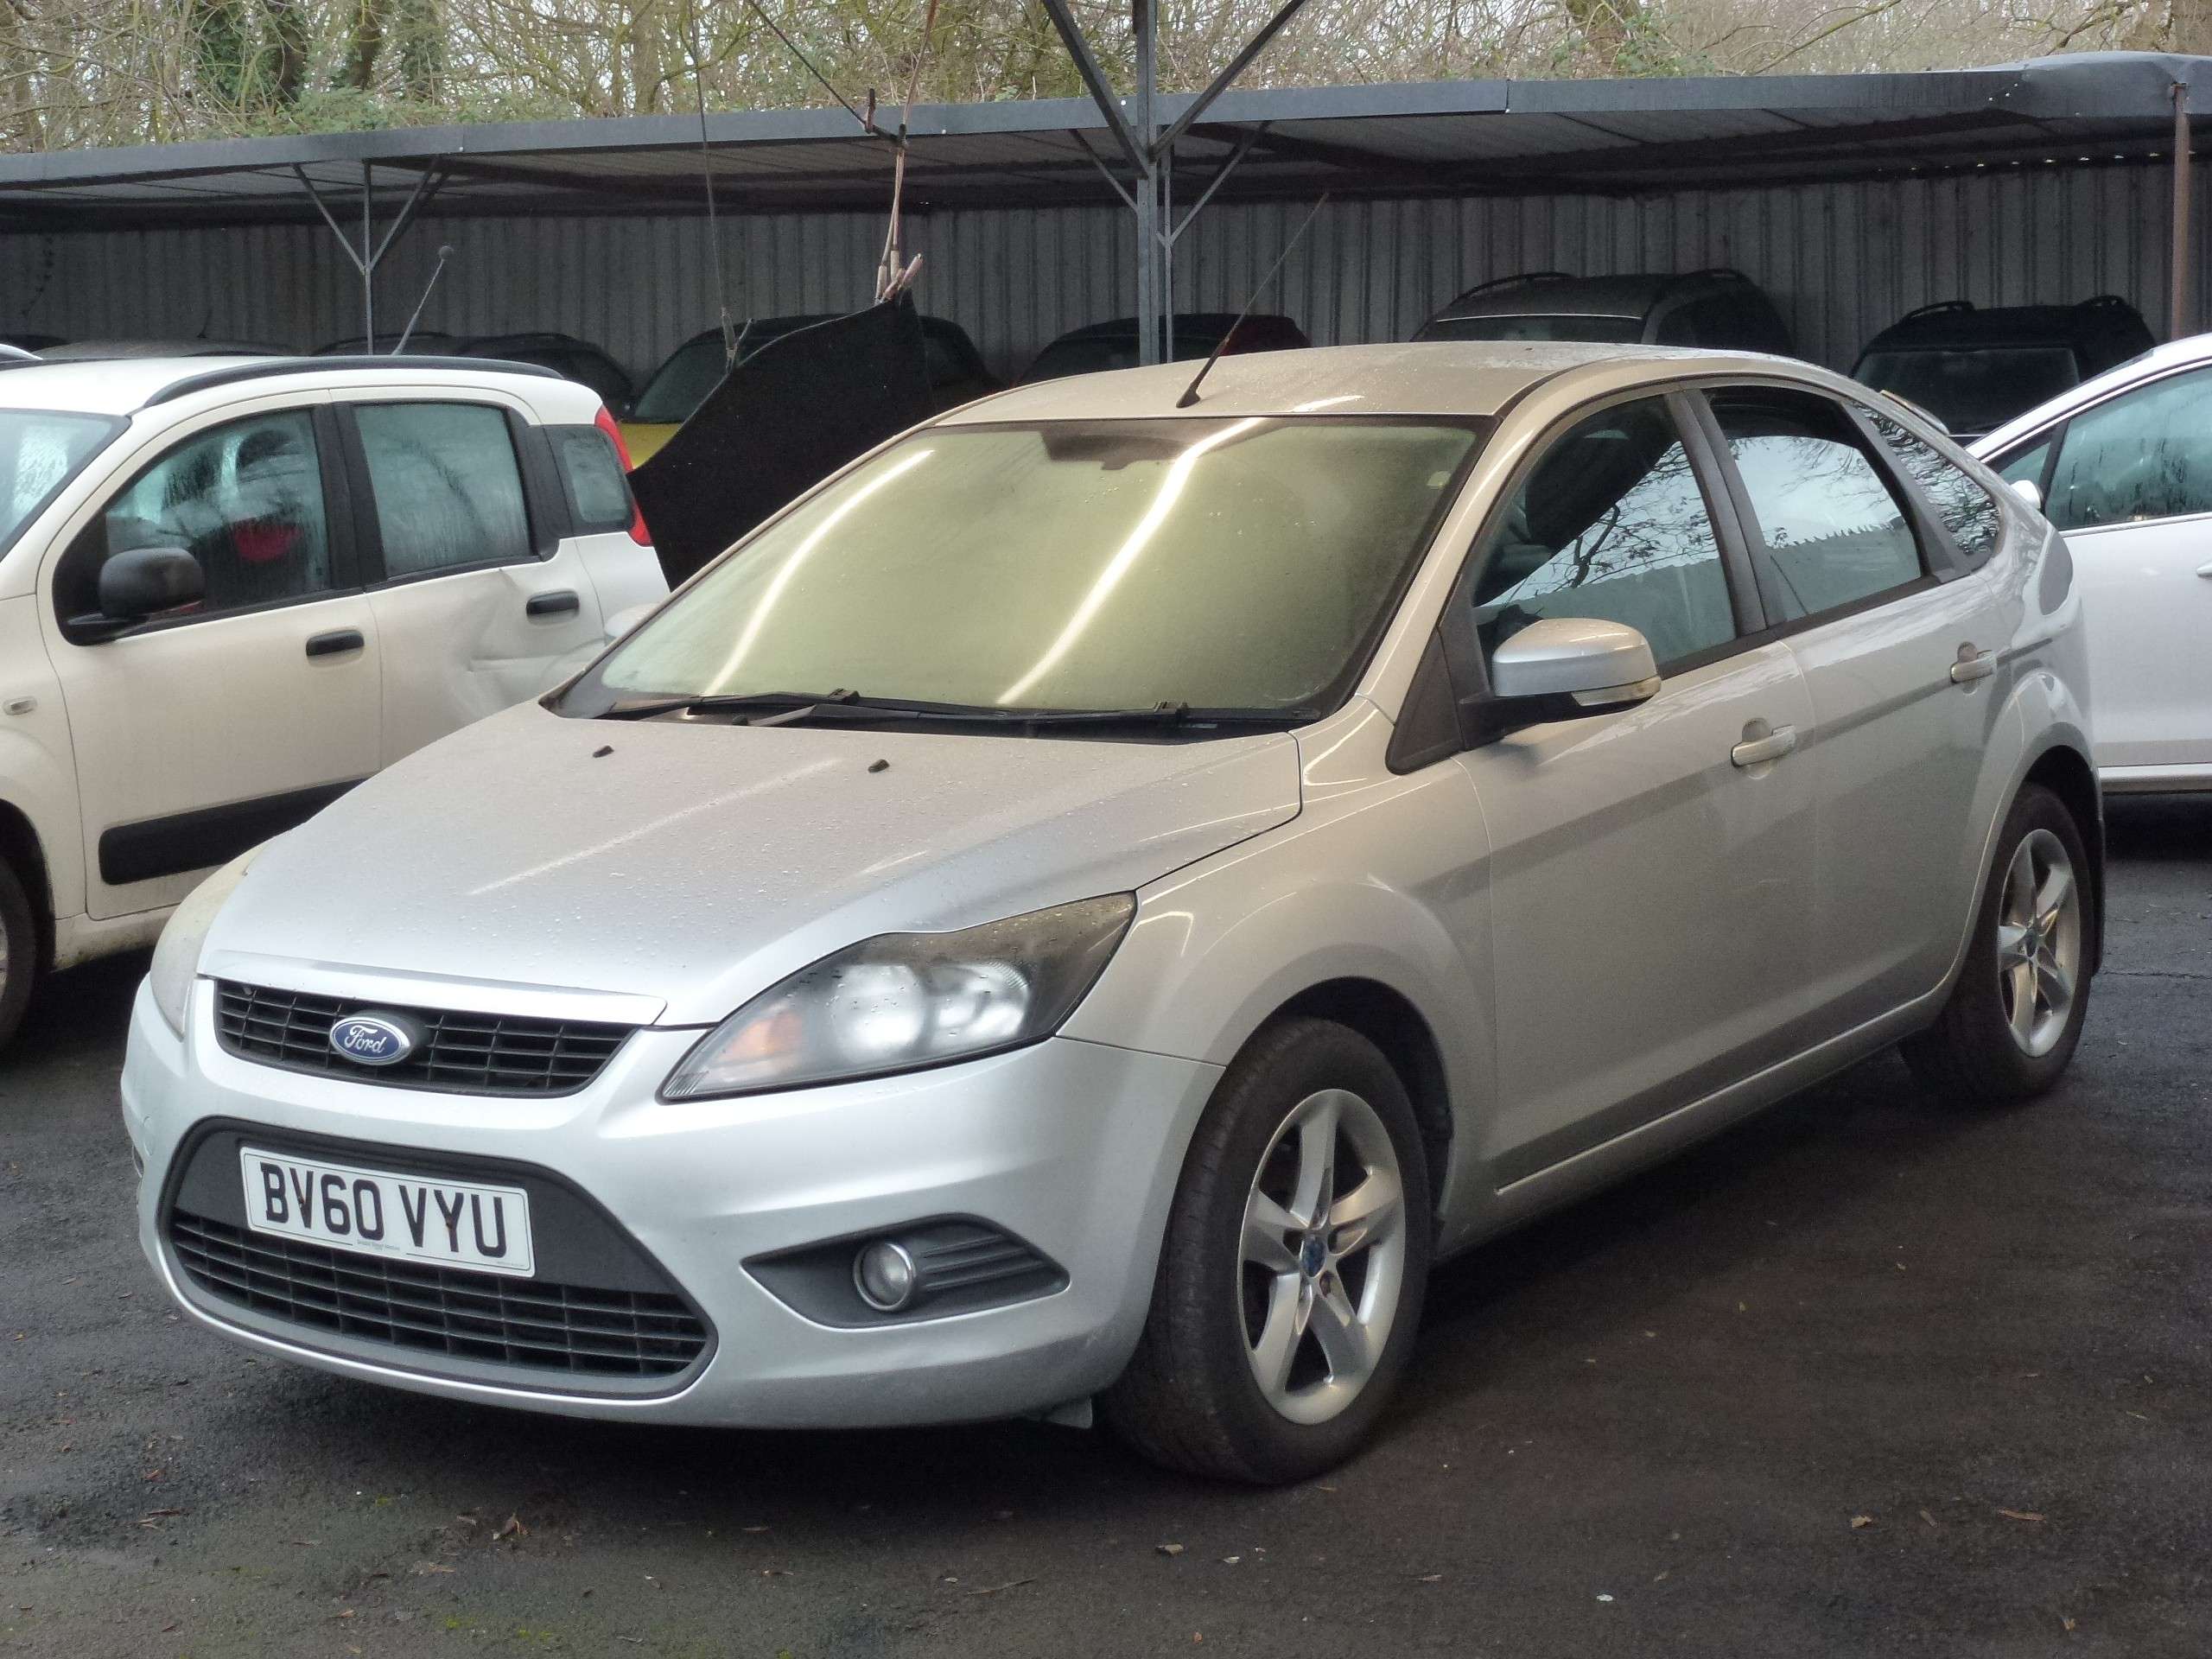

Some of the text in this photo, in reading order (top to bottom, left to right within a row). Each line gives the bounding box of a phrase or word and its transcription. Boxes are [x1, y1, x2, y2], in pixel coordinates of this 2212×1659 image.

[344, 1025, 387, 1053] Ford
[260, 1161, 507, 1258] BV60 VYU
